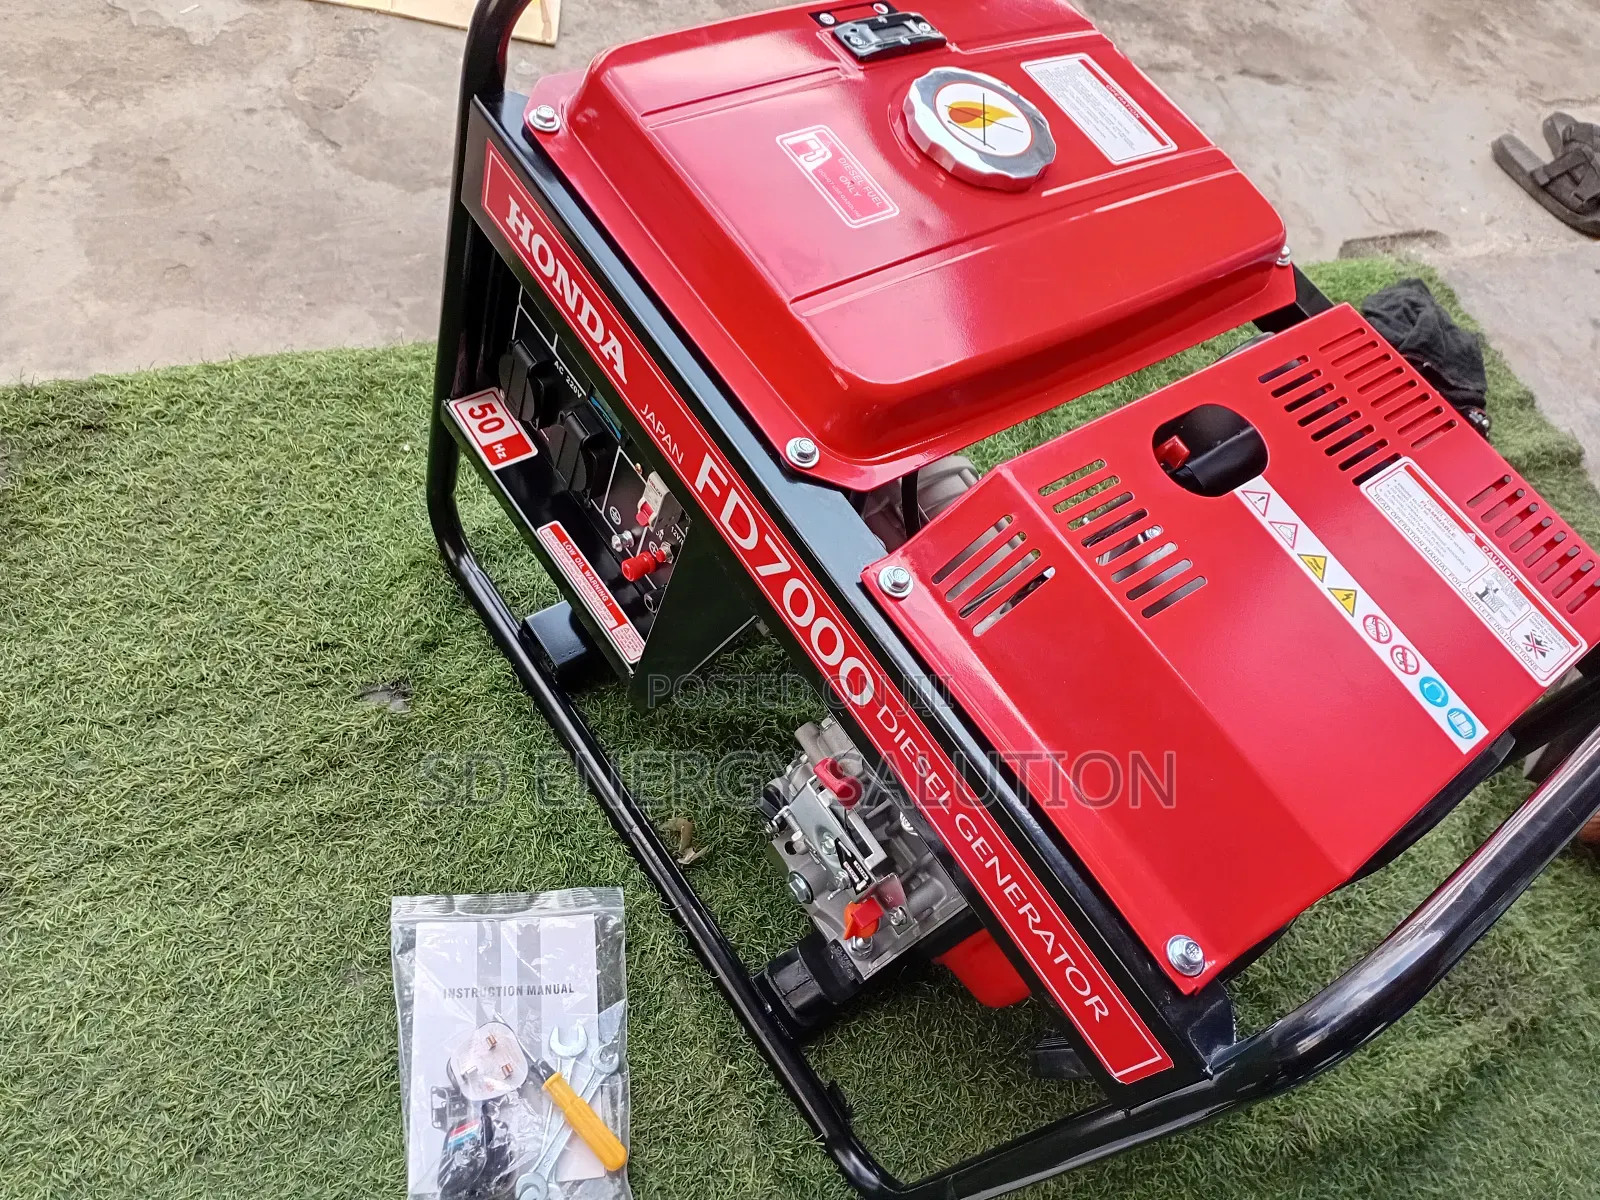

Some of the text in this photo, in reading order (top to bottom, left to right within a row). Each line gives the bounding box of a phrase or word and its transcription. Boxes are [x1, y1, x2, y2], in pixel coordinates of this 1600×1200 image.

[1105, 84, 1141, 119] OPERATION
[838, 157, 883, 208] DIESEL FUEL
[839, 175, 862, 198] ONLY
[505, 194, 628, 385] HONDA
[554, 360, 584, 399] AC 220V
[468, 402, 505, 434] 50
[640, 403, 685, 465] JAPAN
[492, 443, 507, 460] Hz
[1419, 499, 1457, 538] FLAMMABLE
[562, 541, 577, 558] LOW
[574, 557, 584, 570] OIL
[583, 569, 609, 602] WARNING
[1373, 492, 1391, 511] READ
[1389, 509, 1424, 547] OPERATION
[1422, 544, 1448, 573] MANUAL
[1447, 571, 1462, 588] FOR
[1460, 586, 1494, 622] COMPLETE
[1481, 545, 1518, 583] CAUTION
[694, 452, 875, 706] FD7000
[876, 705, 1110, 1023] DIESEL GENERATOR
[443, 983, 575, 999] INSTRUCTION MANUAL
